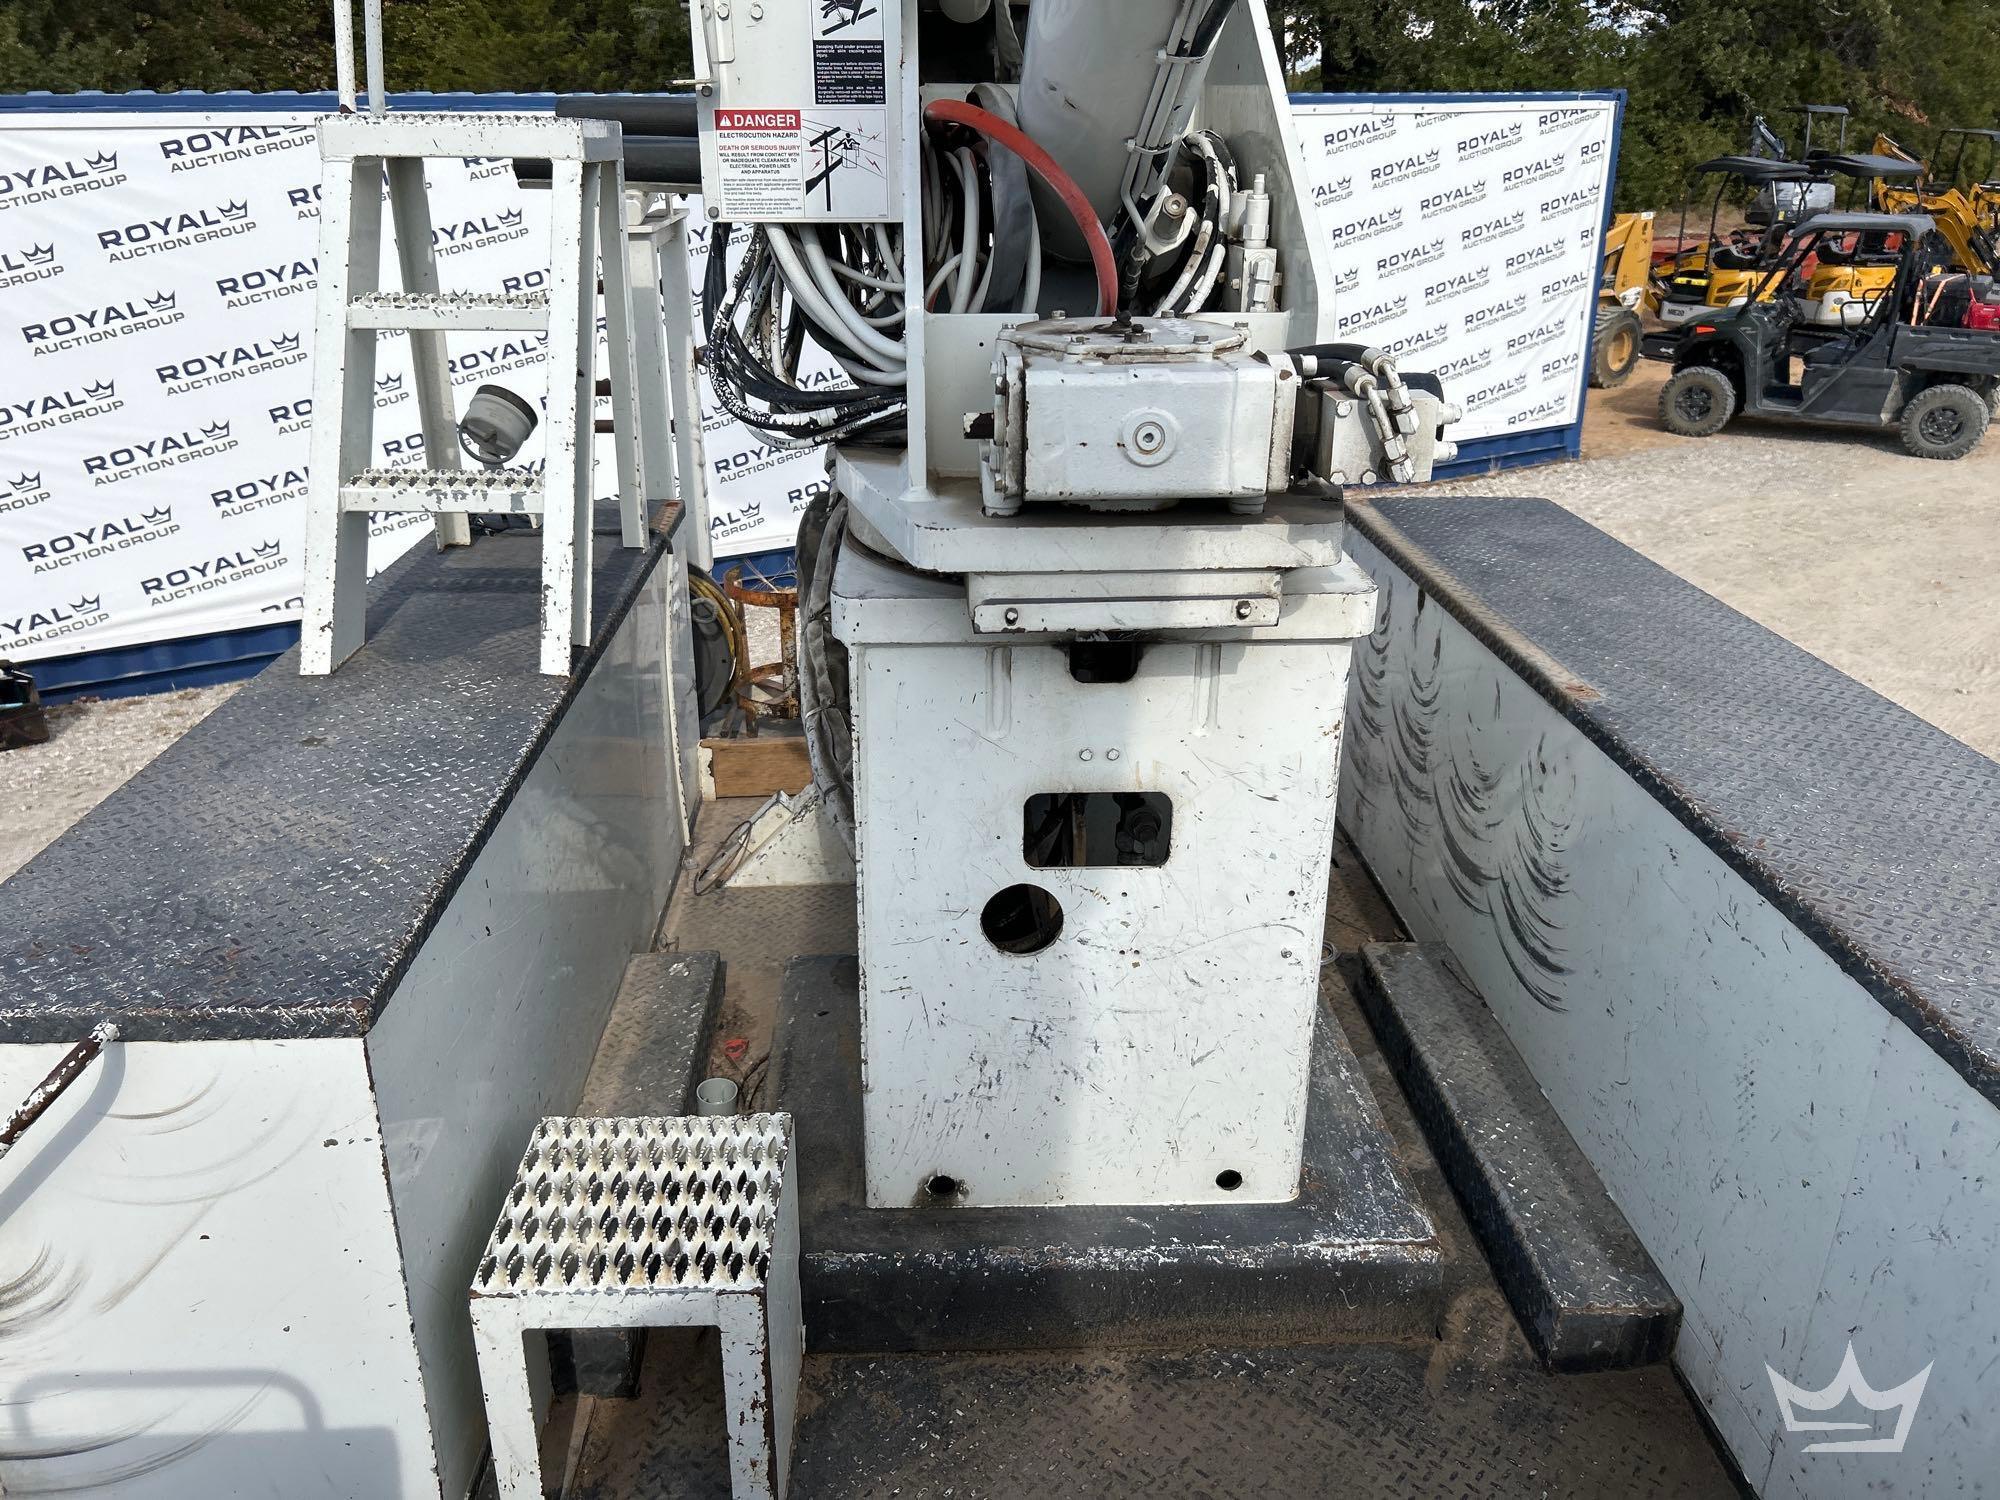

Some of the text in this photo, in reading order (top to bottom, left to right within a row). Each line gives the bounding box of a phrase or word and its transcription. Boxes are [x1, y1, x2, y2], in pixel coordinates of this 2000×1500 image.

[734, 114, 796, 126] DANGER
[1324, 119, 1382, 146] ROYAL
[1539, 110, 1602, 136] AUCTION GROUP
[161, 125, 282, 159] ROYAL
[171, 133, 317, 173] AUCTION GROUP
[1326, 129, 1397, 156] AUCTION GROUP
[1458, 127, 1510, 153] ROYAL
[1458, 137, 1523, 163] AUCTION GROUP
[470, 163, 512, 181] AUCT
[1371, 154, 1427, 181] ROYAL
[1503, 158, 1554, 183] ROYAL
[1581, 153, 1604, 166] AUCTI
[0, 160, 90, 194] OYAL
[1372, 163, 1440, 190] AUCTION GROUP
[1504, 167, 1565, 192] AUCTION GROUP
[0, 174, 127, 210] CTION GROUP
[1322, 191, 1353, 206] GROUP
[1421, 184, 1474, 211] ROYAL
[1541, 191, 1589, 214] ROYAL
[1422, 193, 1486, 220] AUCTION GROUP
[1541, 206, 1573, 221] AUCTION
[98, 208, 222, 249] ROYAL
[431, 216, 500, 247] YAL
[1333, 214, 1389, 240] ROYAL
[1333, 221, 1403, 250] AUCTION GROUP
[1462, 216, 1513, 241] ROYAL
[1463, 224, 1525, 250] AUCTION GROUP
[109, 222, 256, 263] AUCTION GROUP
[433, 228, 529, 259] TION GROUP
[1377, 245, 1432, 271] ROYAL
[1378, 252, 1445, 280] AUCTION GROUP
[1506, 245, 1552, 269] ROYAL
[1506, 250, 1565, 277] AUCTION GROUP
[227, 283, 304, 309] AUCTION
[1335, 281, 1359, 295] ROUP
[1425, 273, 1477, 298] ROYAL
[1425, 279, 1490, 307] AUCTION GROUP
[1542, 272, 1588, 296] ROYAL
[1542, 286, 1575, 304] AUCTION
[21, 300, 149, 343] ROYAL
[1339, 303, 1394, 329] ROYAL
[1340, 309, 1407, 338] AUCTION GROUP
[1465, 301, 1515, 326] ROYAL
[1465, 307, 1526, 334] AUCTION GROUP
[34, 312, 185, 357] AUCTION GROUP
[1380, 331, 1435, 356] ROYAL
[1507, 325, 1554, 350] ROYAL
[1508, 330, 1565, 358] AUCTION GROUP
[156, 340, 274, 383] ROYAL
[447, 337, 539, 375] ROYAL
[514, 352, 548, 368] GRO
[1393, 336, 1448, 363] CTION GROUP
[167, 353, 308, 396] AUCTION GROUP
[1439, 360, 1492, 386] CTION GROUP
[1542, 353, 1579, 374] ROYA
[796, 366, 844, 391] YAL
[373, 392, 409, 410] OUP
[1467, 380, 1515, 405] ROYAL
[1467, 385, 1527, 413] AUCTION GROUP
[0, 389, 88, 426] OYAL
[0, 400, 124, 440] CTION GROUP
[1508, 402, 1554, 425] ROYAL
[701, 415, 739, 434] ROUP
[83, 429, 204, 474] ROYAL
[95, 440, 238, 487] AUCTION GROUP
[714, 444, 785, 474] ROYA
[718, 444, 820, 484] AUCTION GROUP
[0, 492, 51, 513] ROUP
[788, 479, 834, 503] ROY
[221, 491, 295, 519] AUCTION
[397, 512, 431, 529] GRO
[721, 517, 765, 537] GROUP
[22, 516, 146, 562] ROYAL
[34, 524, 180, 574] AUCTION GROUP
[140, 549, 256, 595] ROYAL
[152, 557, 288, 607] AUCTION GROUP
[0, 605, 74, 635] YAL
[0, 613, 111, 651] TION GROUP
